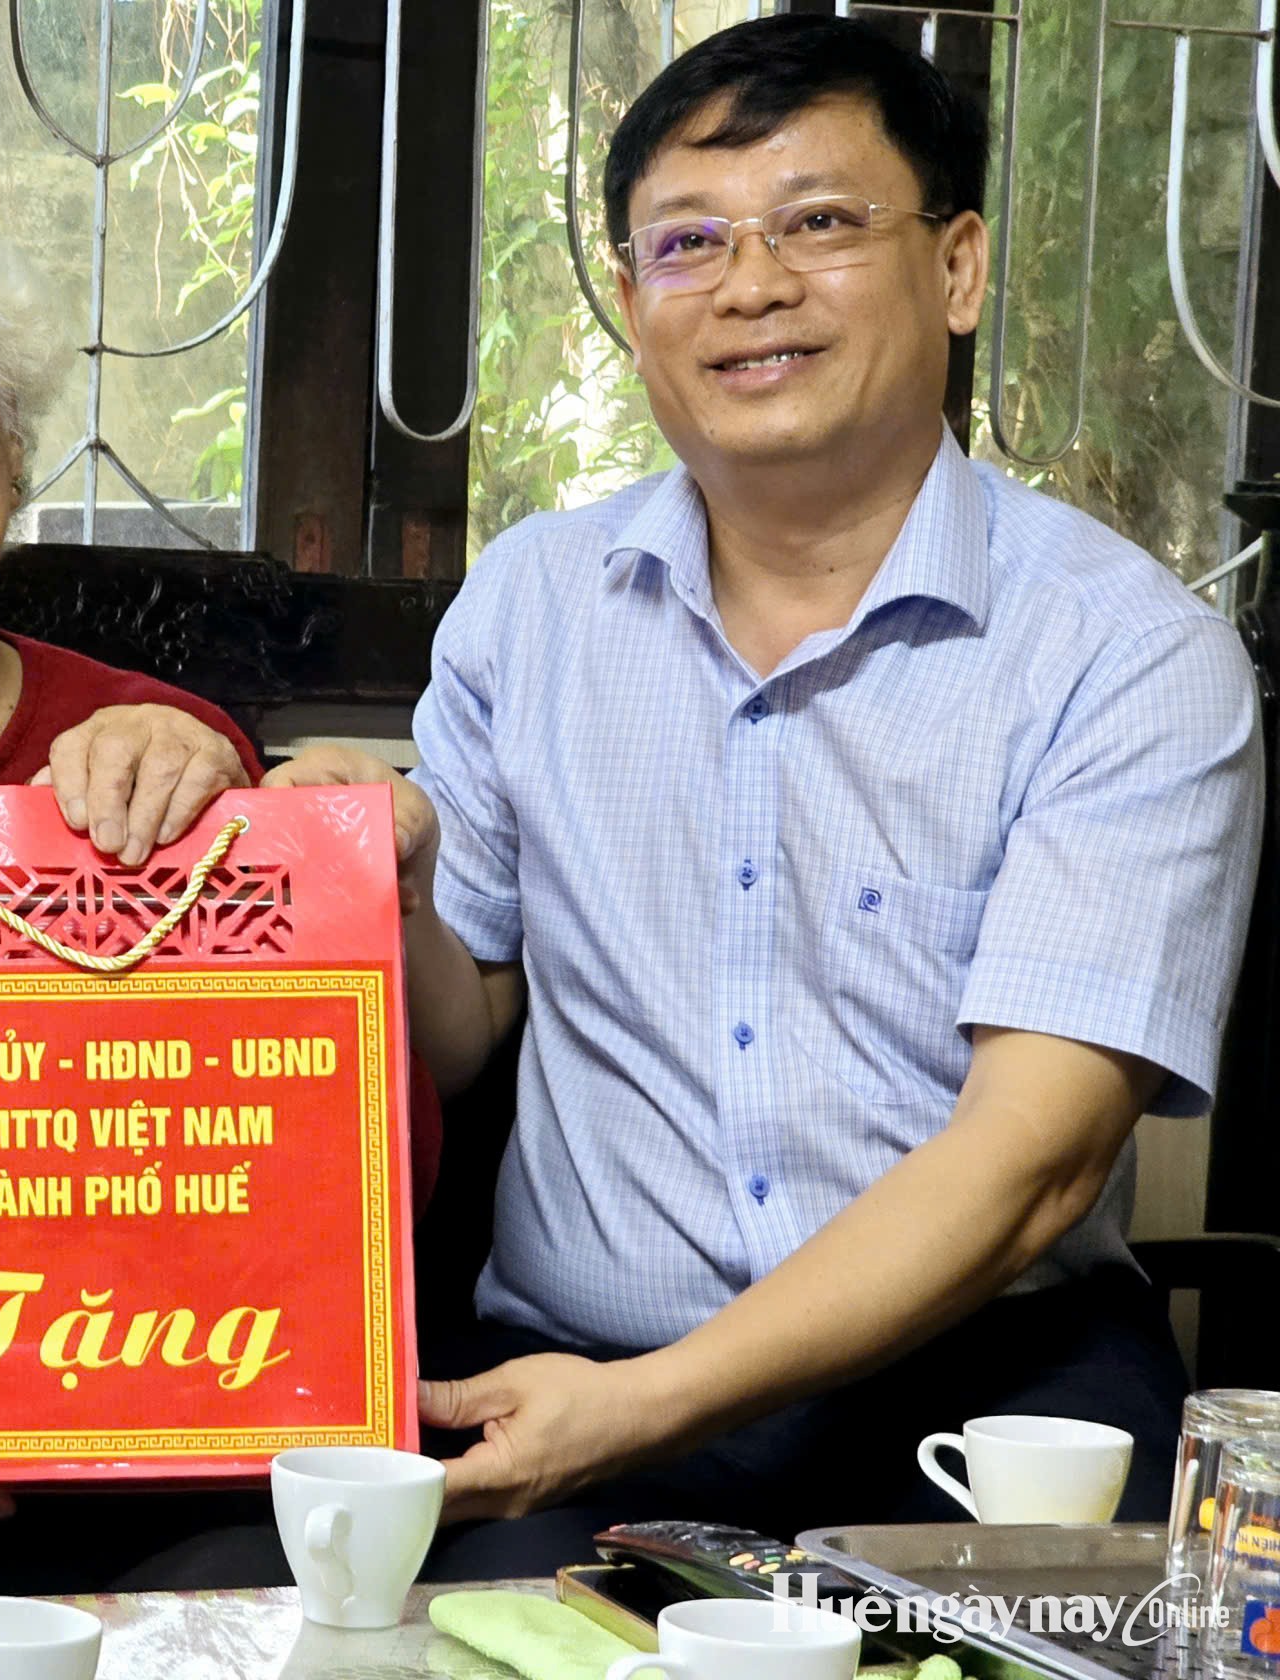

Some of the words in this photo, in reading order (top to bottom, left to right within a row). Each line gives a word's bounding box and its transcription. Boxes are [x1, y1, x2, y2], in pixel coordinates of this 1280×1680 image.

[58, 1059, 74, 1069] -
[85, 1039, 192, 1081] HĐND
[204, 1056, 219, 1067] -
[231, 1037, 337, 1079] UBND
[89, 1099, 172, 1156] VIỆT
[183, 1105, 274, 1146] NAM
[84, 1161, 163, 1216] PHỐ
[175, 1160, 252, 1214] HUẾ
